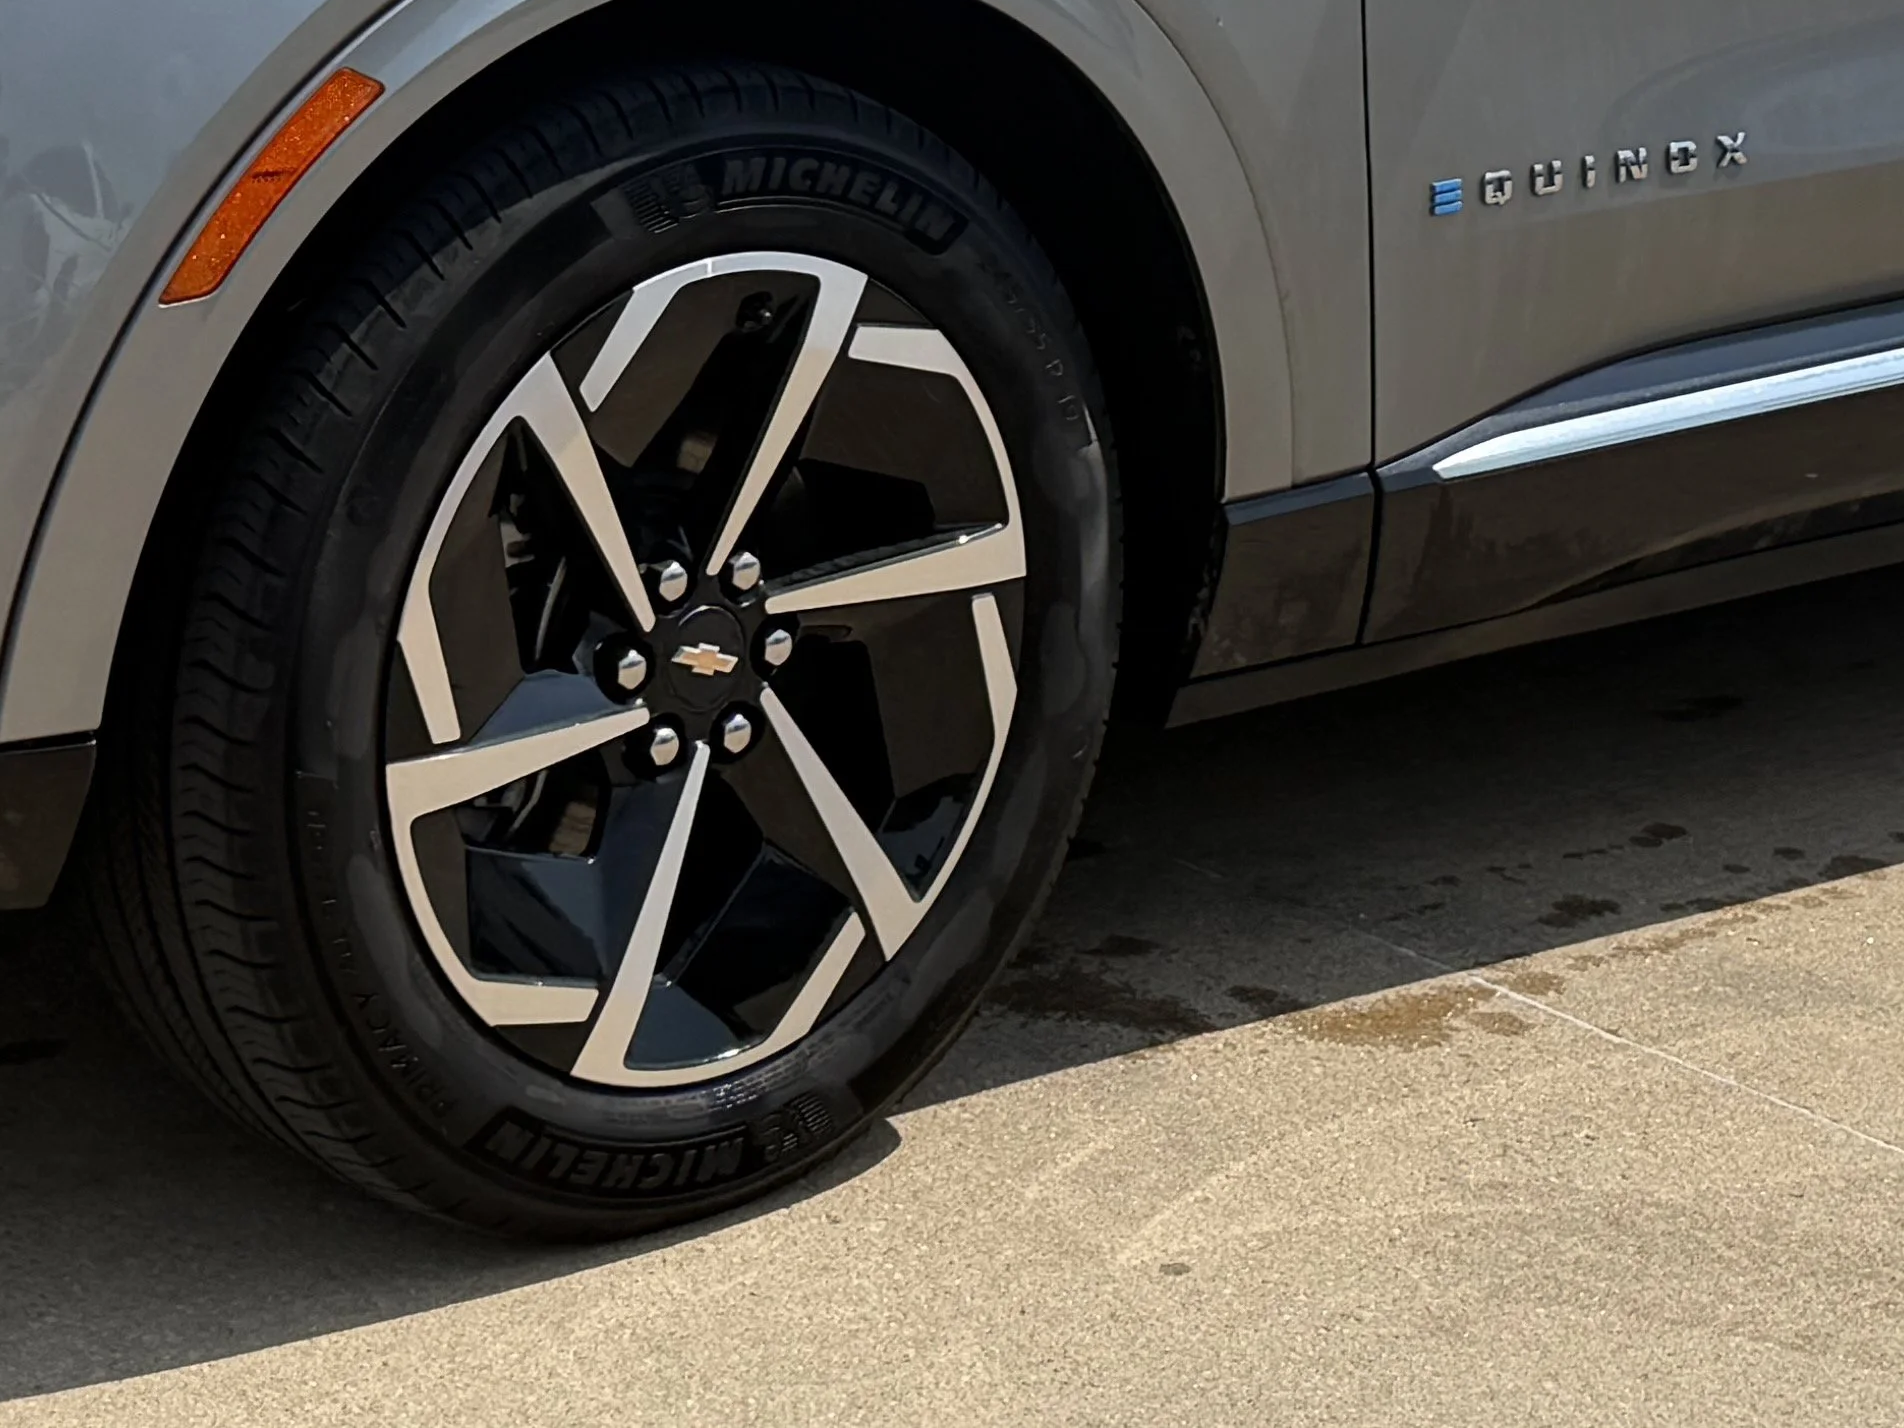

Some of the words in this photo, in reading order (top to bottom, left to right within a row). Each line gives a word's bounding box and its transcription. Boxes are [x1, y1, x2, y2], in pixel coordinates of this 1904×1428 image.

[720, 156, 957, 242] MICHELIN
[1430, 132, 1748, 216] EQUINOX
[484, 1120, 745, 1190] MICHELIN
